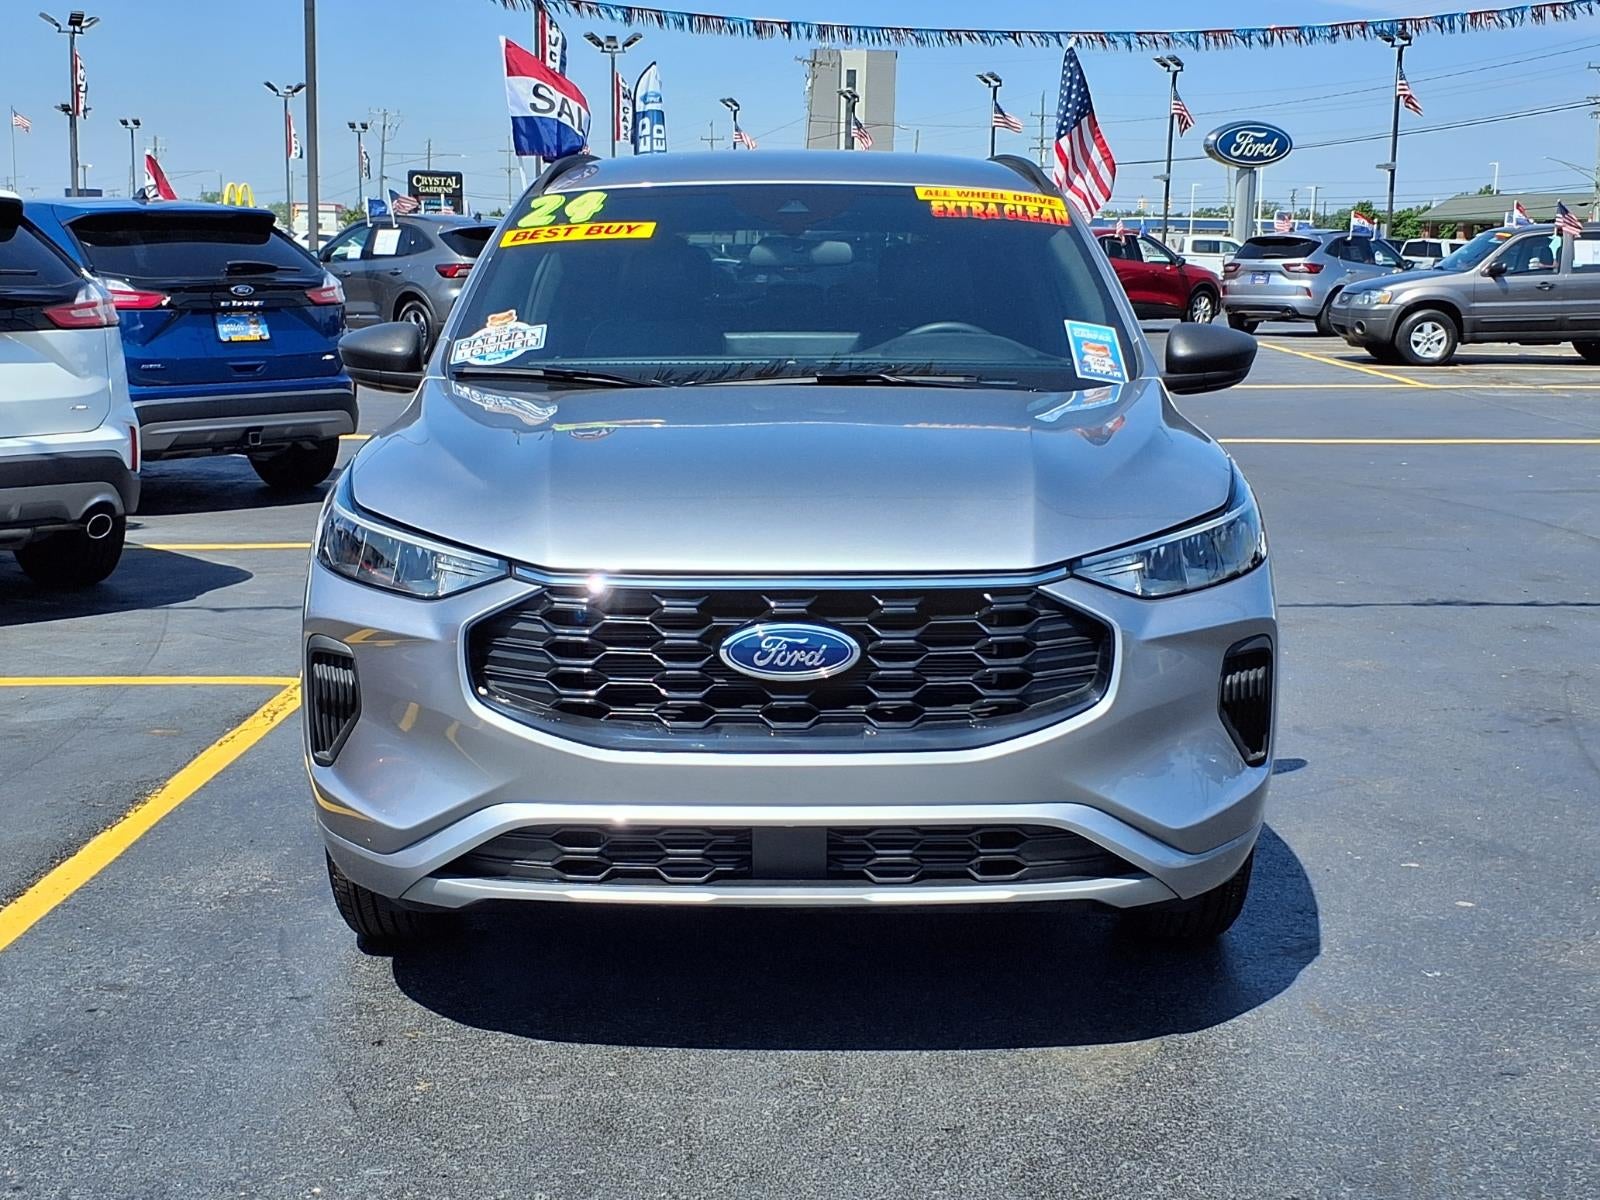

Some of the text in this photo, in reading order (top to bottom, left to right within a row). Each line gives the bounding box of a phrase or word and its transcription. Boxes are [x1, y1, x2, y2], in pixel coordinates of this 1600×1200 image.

[1230, 130, 1279, 157] Ford
[412, 174, 461, 189] CRYSTAL
[419, 186, 453, 194] GARDENS
[923, 188, 1058, 206] ALL WHEEL DRIVE
[517, 191, 608, 227] 24
[931, 200, 1071, 226] EXTRA CLEAN
[510, 224, 643, 243] BEST BUY
[753, 635, 826, 667] Ford
